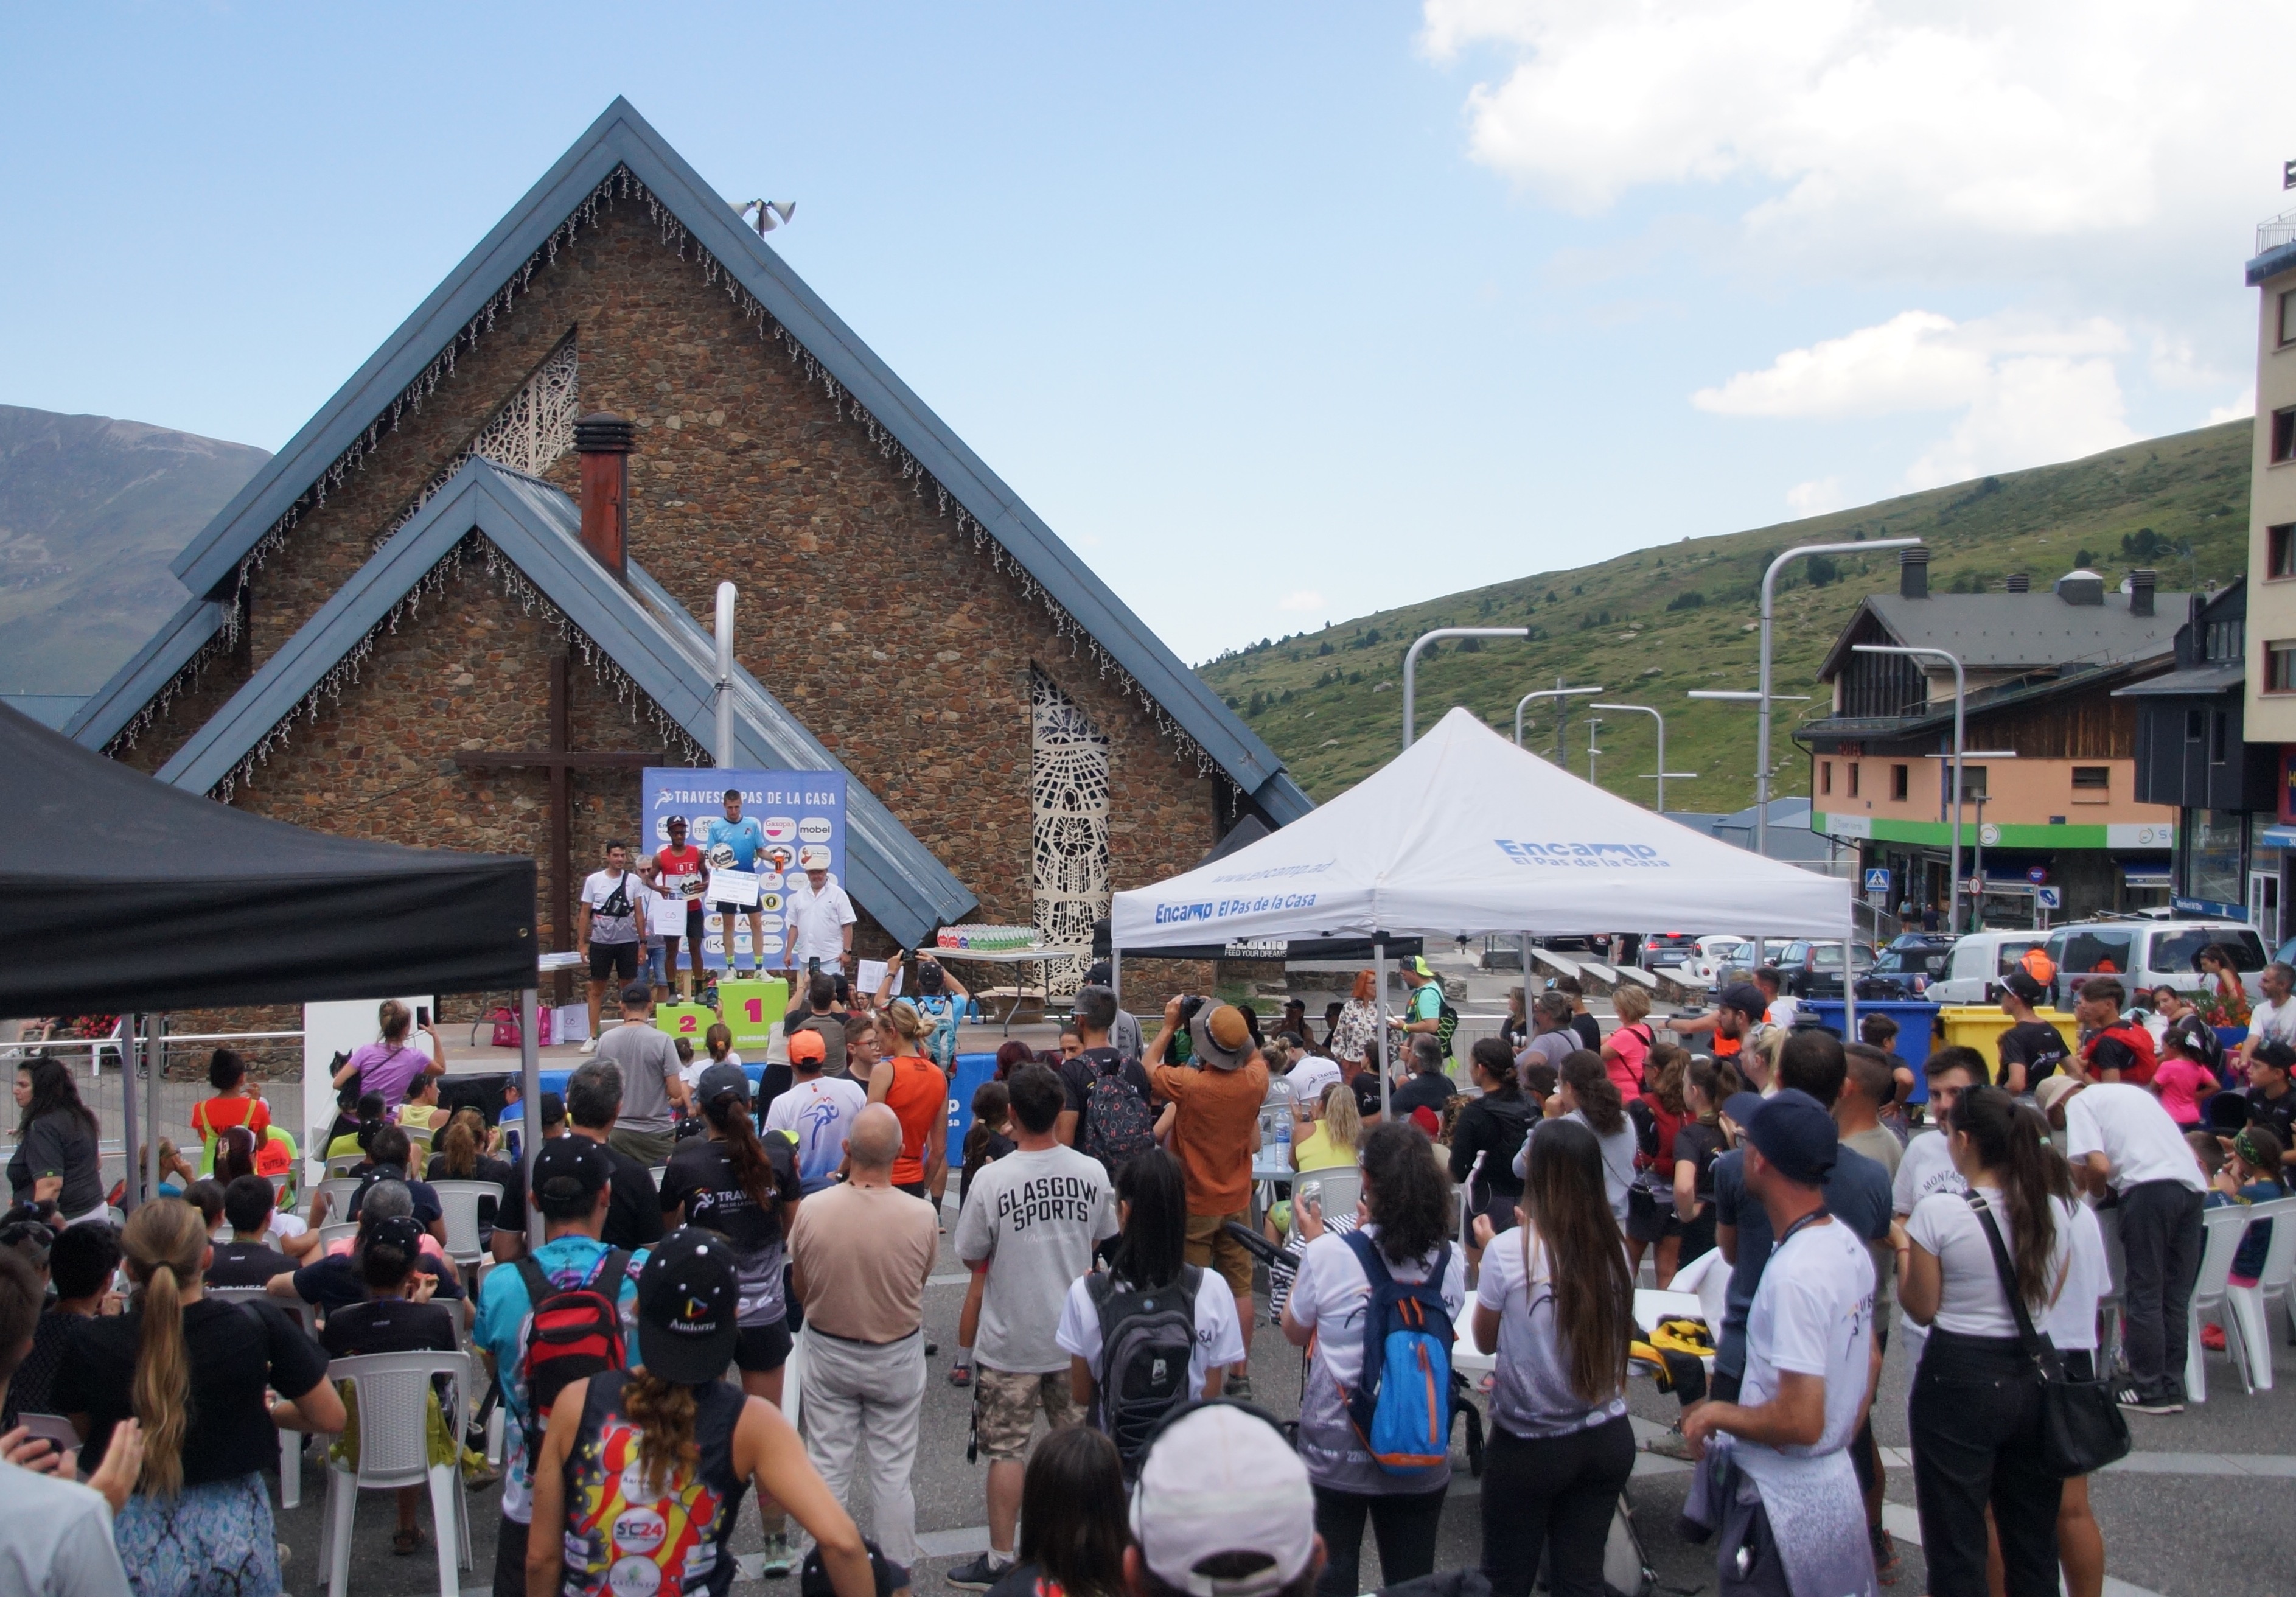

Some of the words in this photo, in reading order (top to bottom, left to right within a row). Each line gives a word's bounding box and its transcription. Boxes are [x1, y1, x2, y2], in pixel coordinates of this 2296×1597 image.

[768, 792, 782, 804] DE
[787, 792, 800, 805] LA
[806, 792, 836, 805] CASA
[1493, 839, 1657, 859] Encamp
[1212, 858, 1337, 883] www.encamp.ad
[1510, 857, 1531, 865] El
[1534, 857, 1570, 866] Pas
[1573, 858, 1599, 867] de
[1600, 858, 1621, 867] la
[1622, 858, 1670, 867] Casa
[1155, 901, 1213, 924] Encamp
[1218, 900, 1229, 917] El
[1230, 900, 1252, 915] Pas
[1253, 896, 1269, 912] de
[1271, 894, 1283, 910] la
[1285, 893, 1316, 909] Casa
[744, 998, 762, 1023] 1
[679, 1015, 697, 1032] 2
[998, 1176, 1097, 1218] GLASGOW
[1013, 1199, 1088, 1232] SPORTS
[670, 1318, 716, 1332] Andorra
